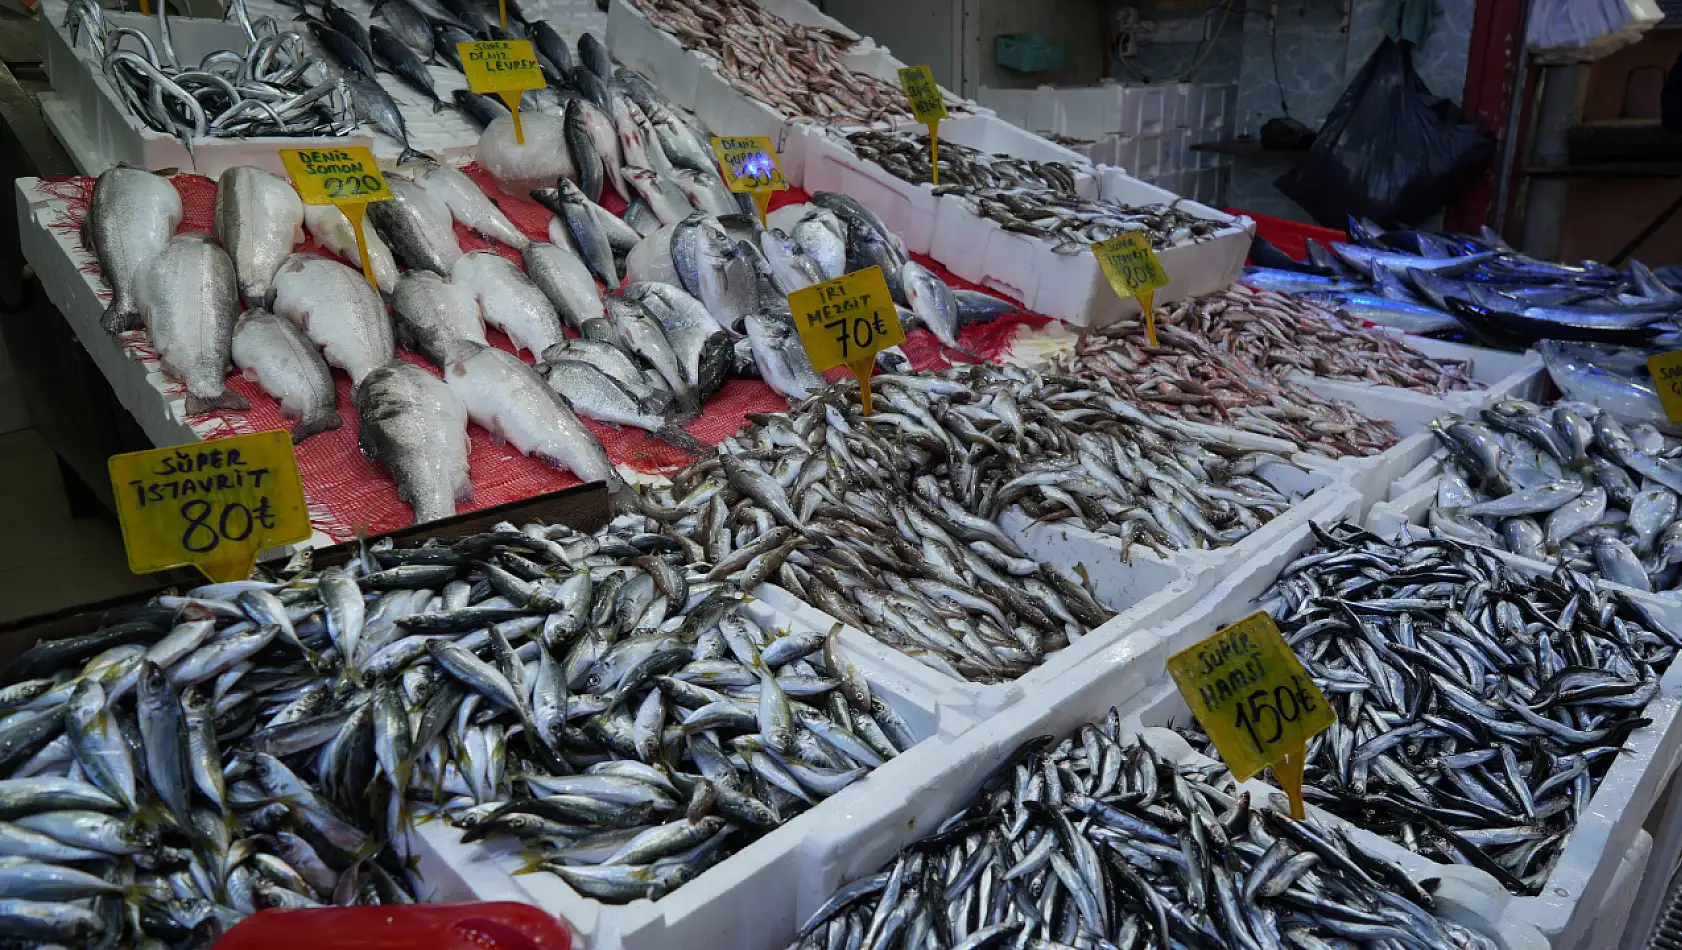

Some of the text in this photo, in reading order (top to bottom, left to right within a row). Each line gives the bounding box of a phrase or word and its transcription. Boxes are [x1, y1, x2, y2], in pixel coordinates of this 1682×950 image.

[298, 150, 353, 164] DENİZ
[304, 161, 364, 175] SOMON
[323, 174, 381, 198] 220
